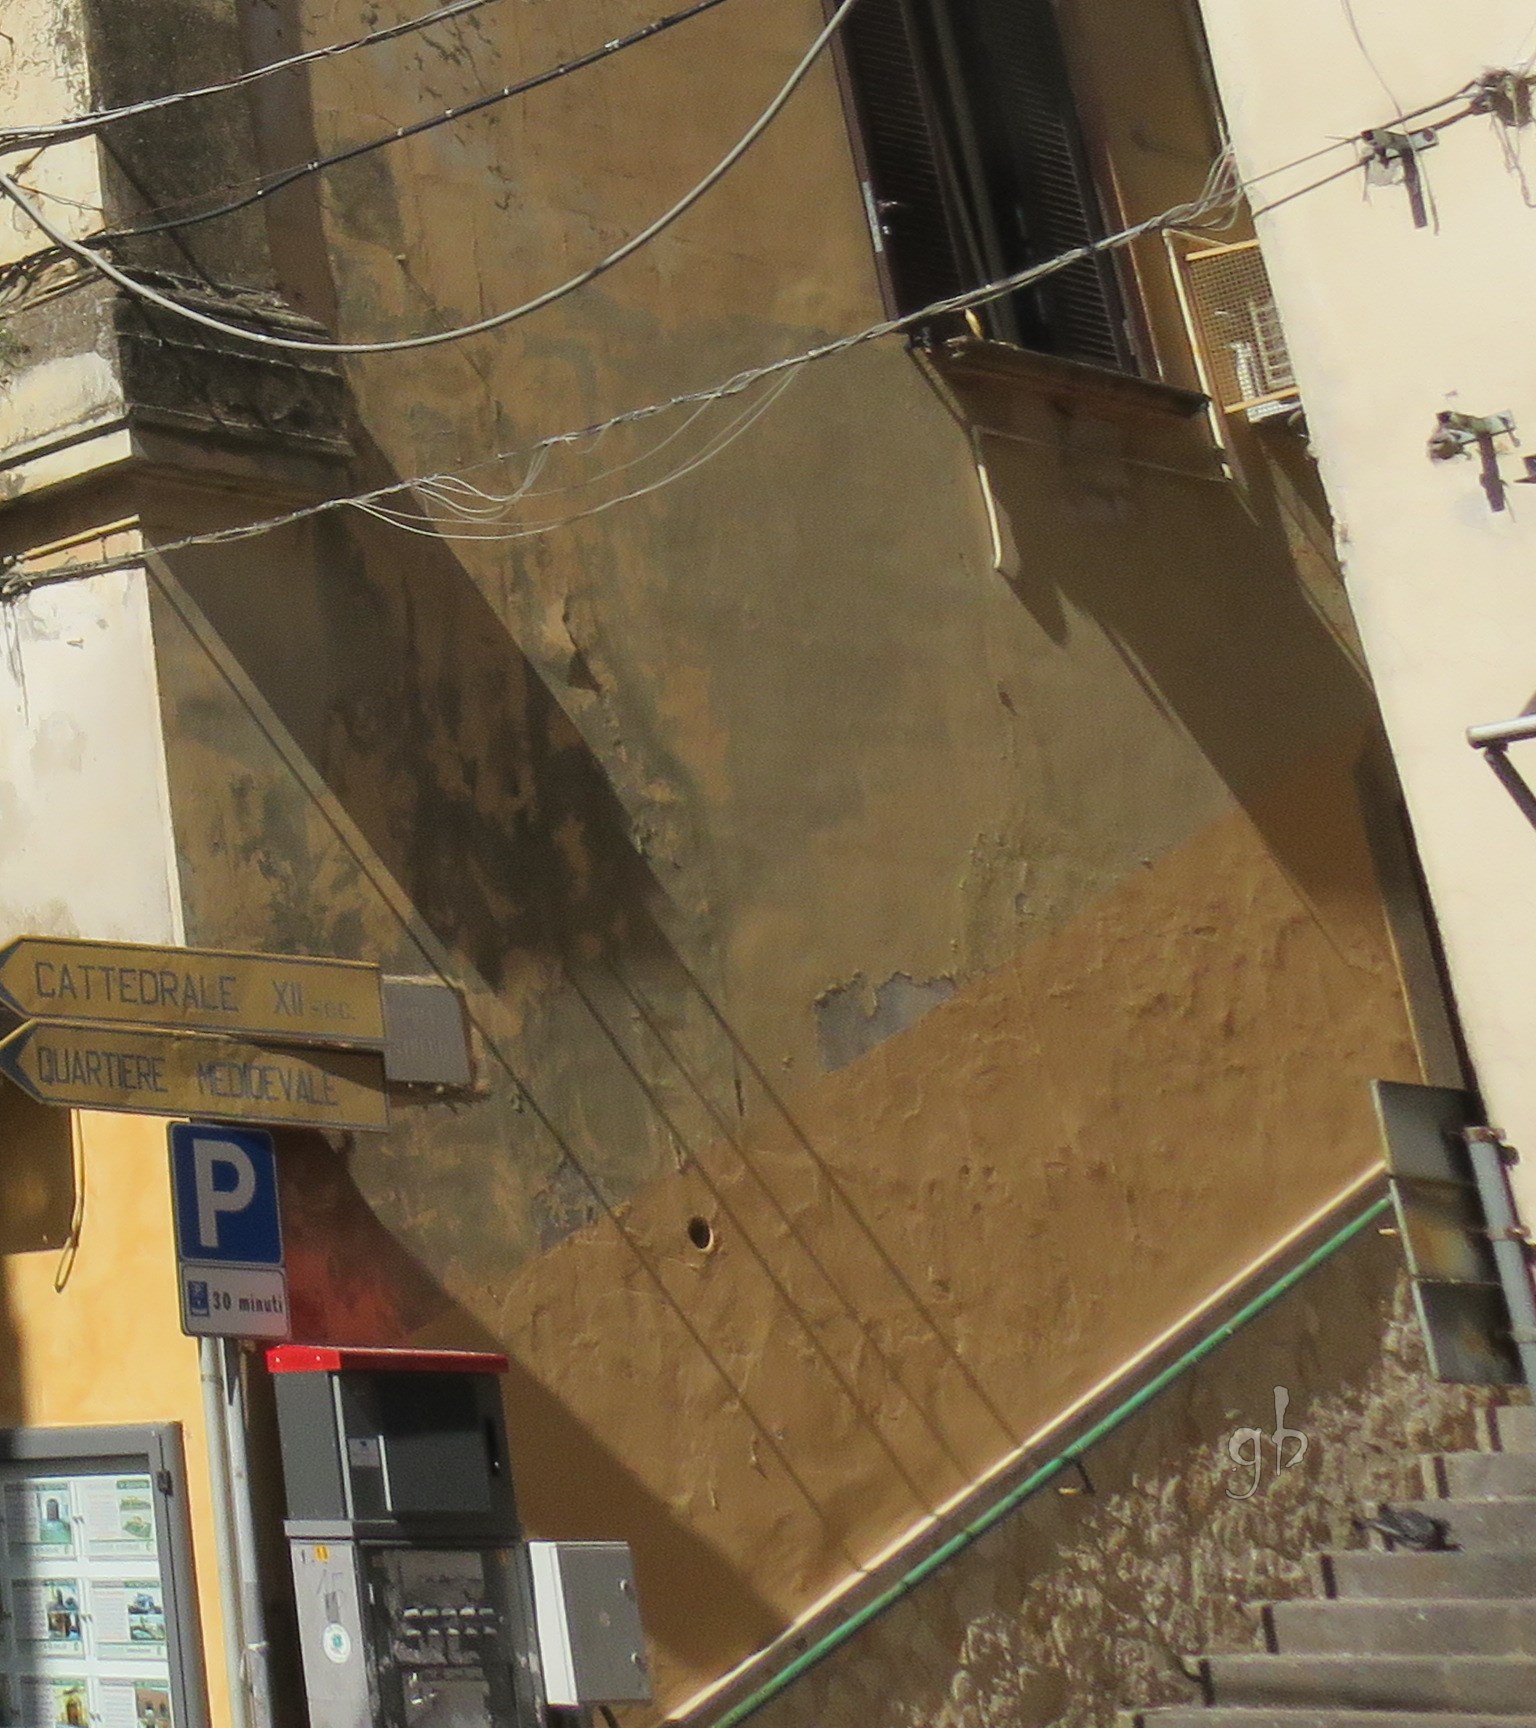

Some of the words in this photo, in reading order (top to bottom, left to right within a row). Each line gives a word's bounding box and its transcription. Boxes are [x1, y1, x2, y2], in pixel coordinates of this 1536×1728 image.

[35, 961, 239, 1012] CATTEDRALE
[272, 980, 304, 1017] XII
[36, 1047, 168, 1093] QUARTIERE
[197, 1060, 339, 1107] MEDIOEVALE
[193, 1139, 256, 1248] P
[212, 1292, 232, 1311] 30
[238, 1294, 283, 1313] minuti
